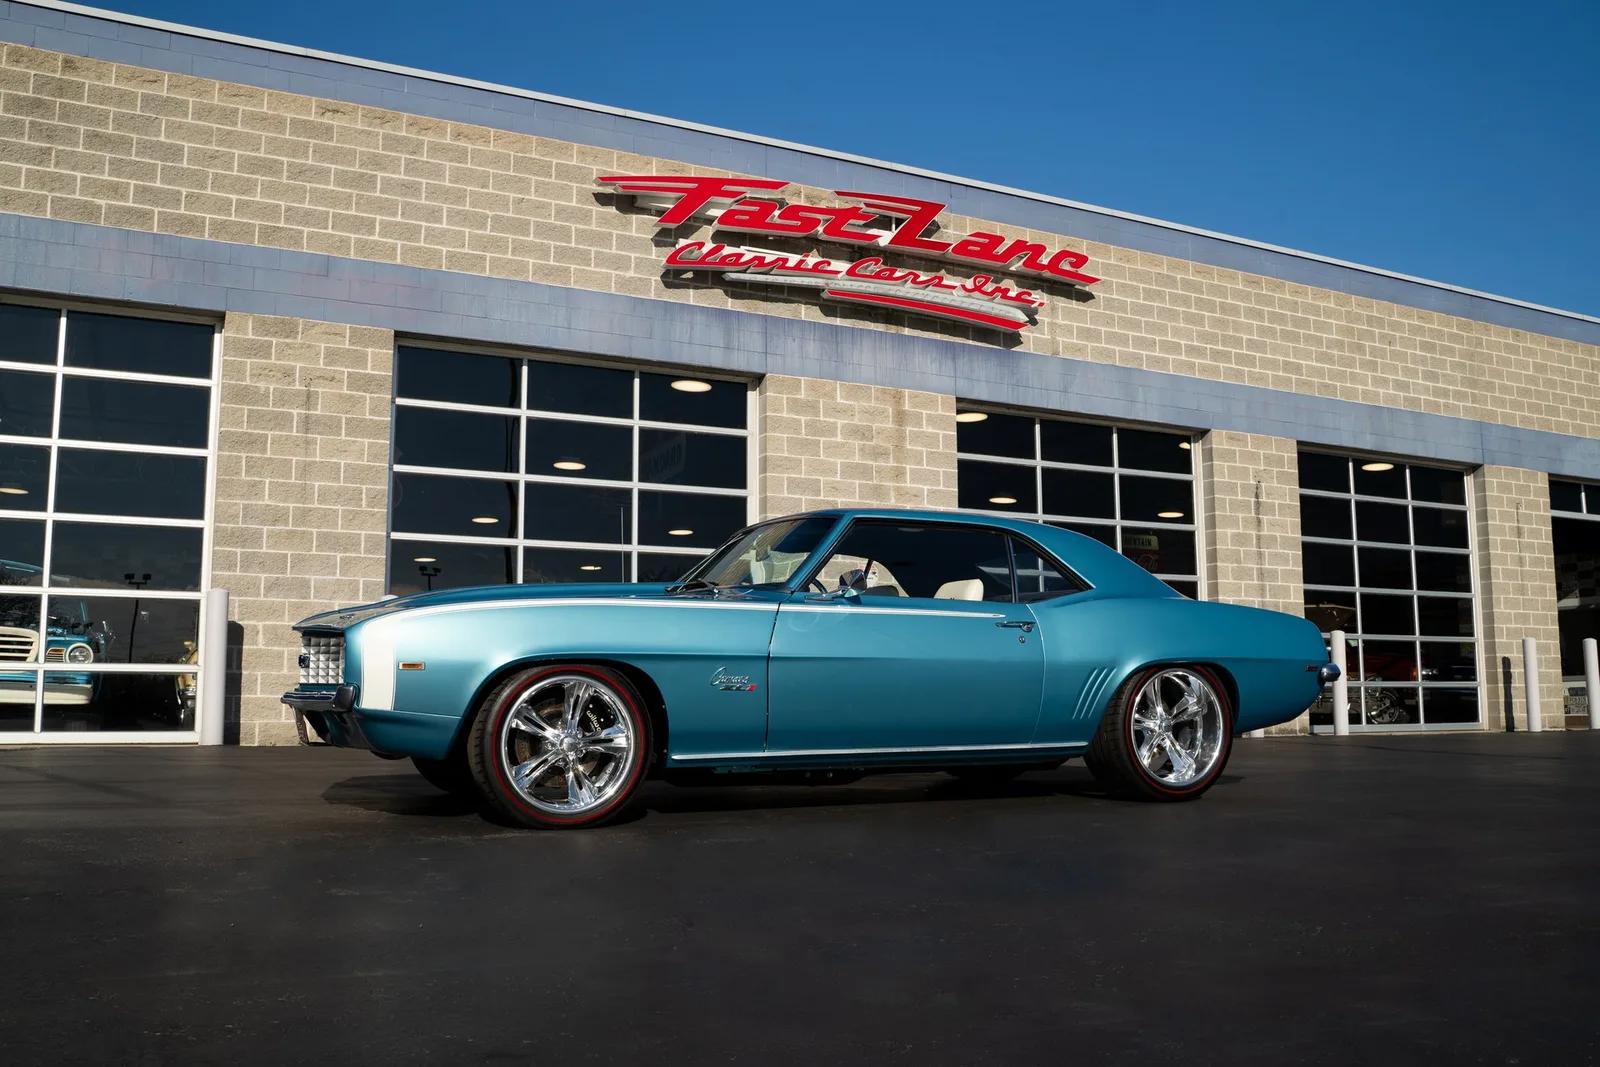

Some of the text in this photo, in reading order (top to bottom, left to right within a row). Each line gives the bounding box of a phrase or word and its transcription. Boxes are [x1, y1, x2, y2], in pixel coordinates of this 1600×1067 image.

[597, 175, 1102, 286] Fast Lane
[664, 241, 1046, 308] Classic Cars Inc.
[586, 710, 602, 732] wilwo
